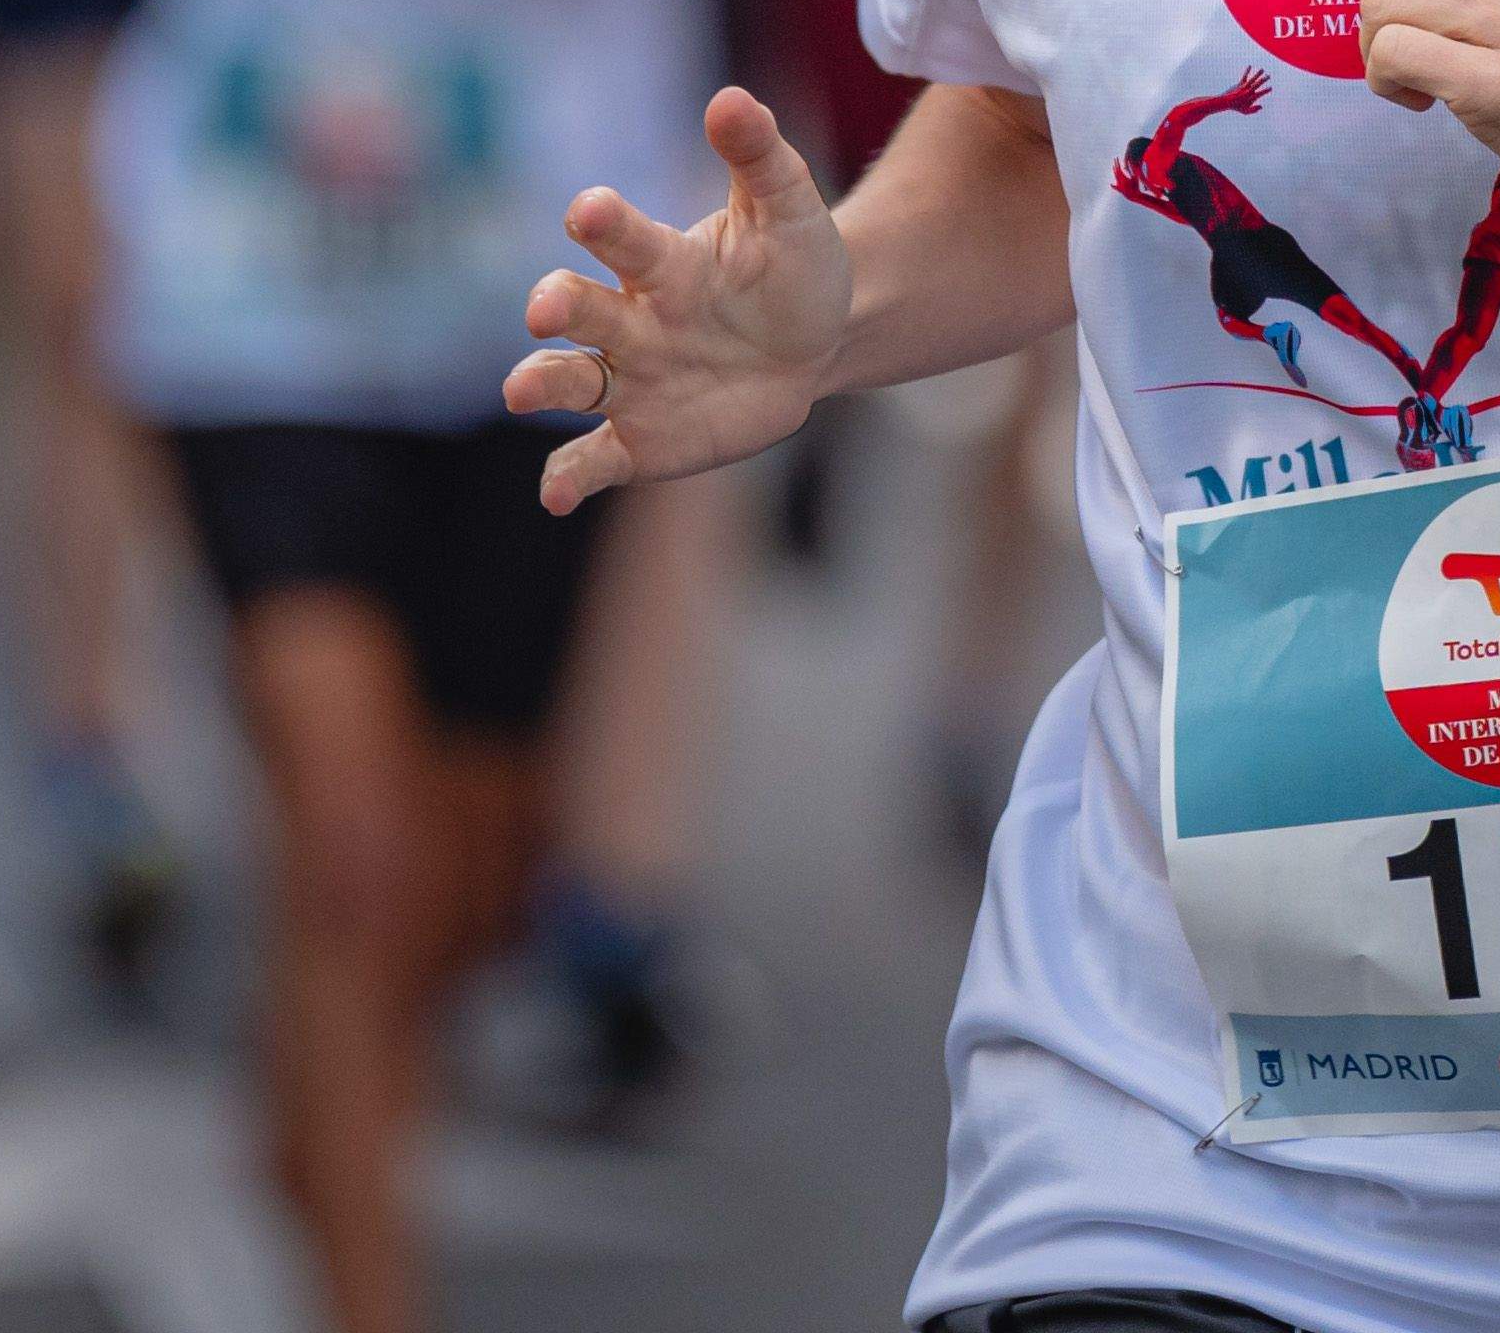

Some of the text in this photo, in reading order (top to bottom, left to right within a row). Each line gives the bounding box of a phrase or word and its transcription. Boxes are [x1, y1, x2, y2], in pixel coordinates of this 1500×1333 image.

[1272, 14, 1316, 39] DE
[1462, 744, 1500, 767] DE
[1306, 1052, 1459, 1081] MADRID
